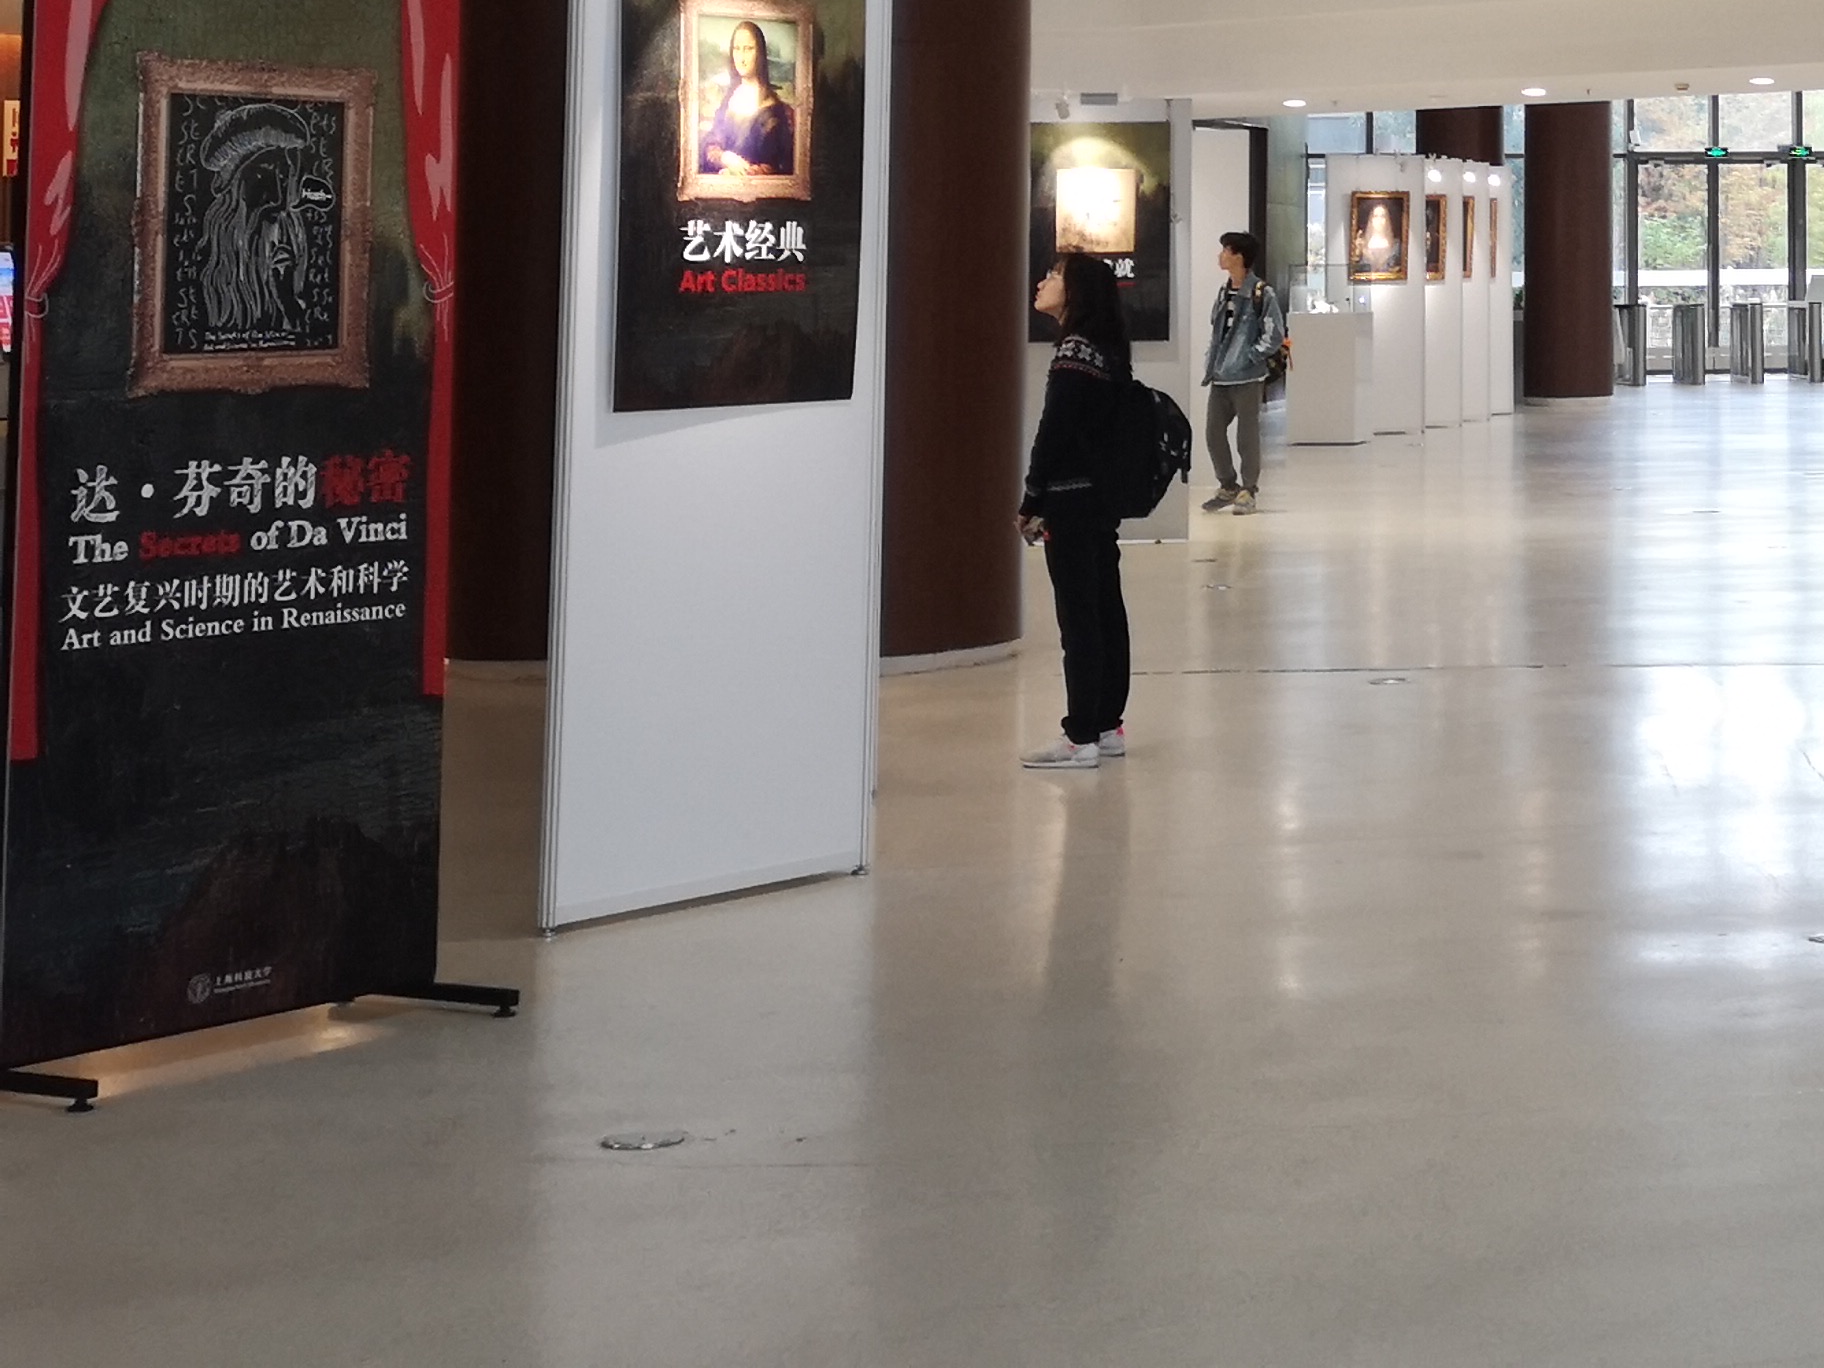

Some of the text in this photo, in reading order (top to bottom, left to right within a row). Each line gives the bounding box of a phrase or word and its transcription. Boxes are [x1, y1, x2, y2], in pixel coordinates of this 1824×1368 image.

[679, 220, 807, 263] 艺术经典
[680, 267, 806, 292] Art Classics
[69, 514, 408, 565] The Secrets of Da Vinci
[58, 560, 409, 623] 文艺复兴时期的艺术和科学
[60, 601, 406, 651] Art and Science in Renaissance
